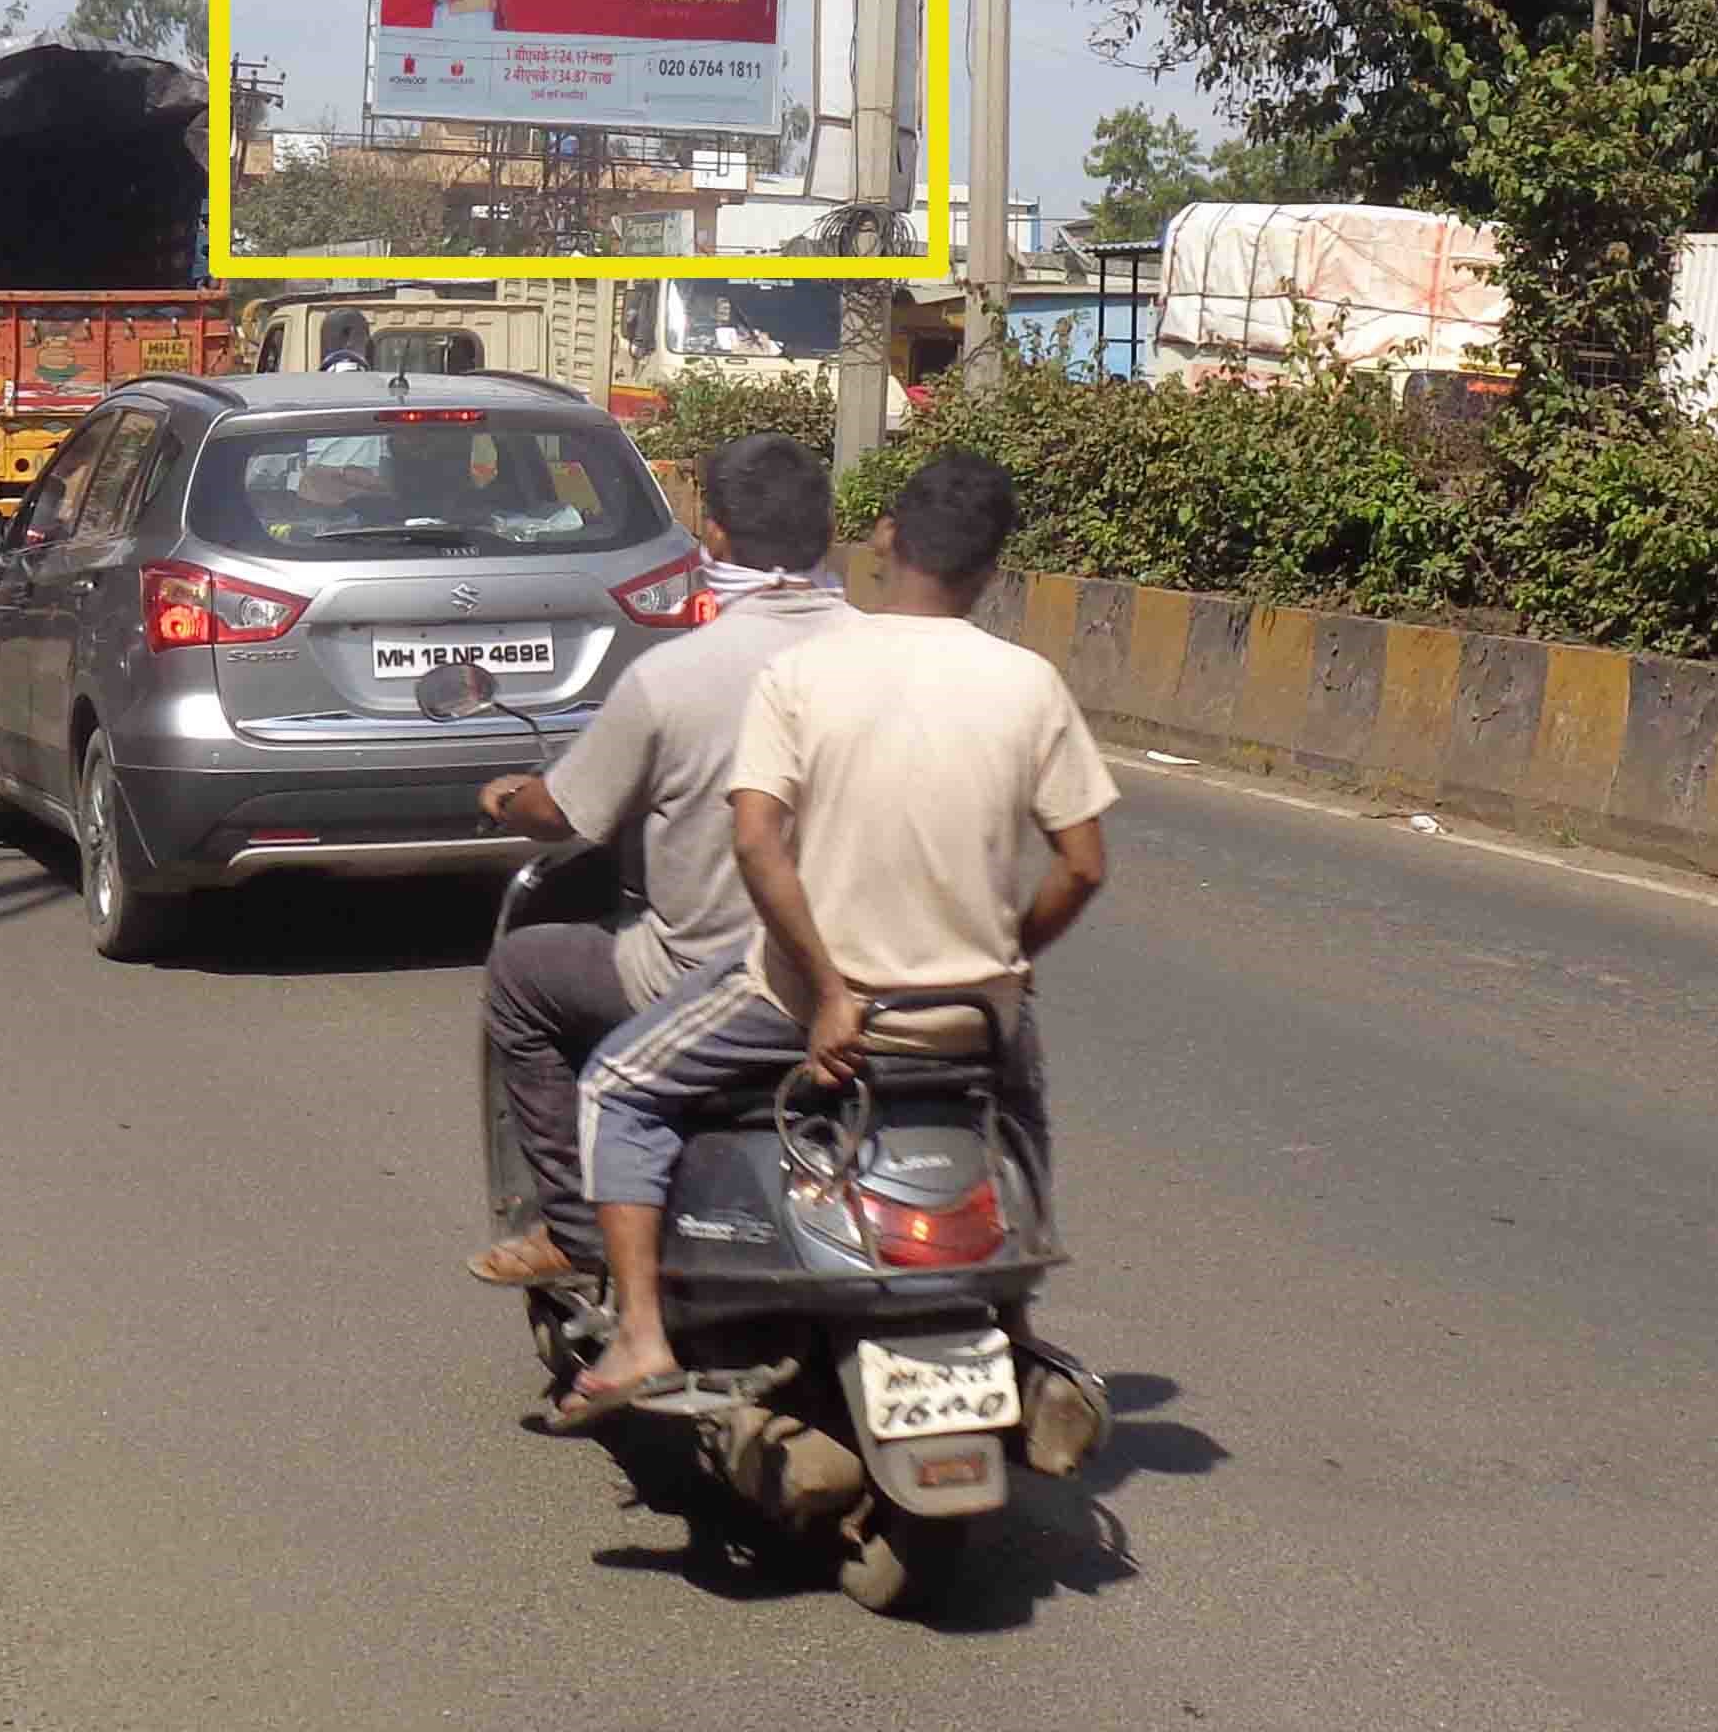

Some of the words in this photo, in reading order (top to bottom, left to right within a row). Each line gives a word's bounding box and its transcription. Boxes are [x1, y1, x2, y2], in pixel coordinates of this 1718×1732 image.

[659, 59, 684, 76] 020
[689, 59, 723, 77] 6764
[728, 60, 762, 79] 1811
[377, 648, 415, 667] MH
[489, 644, 550, 663] 4692
